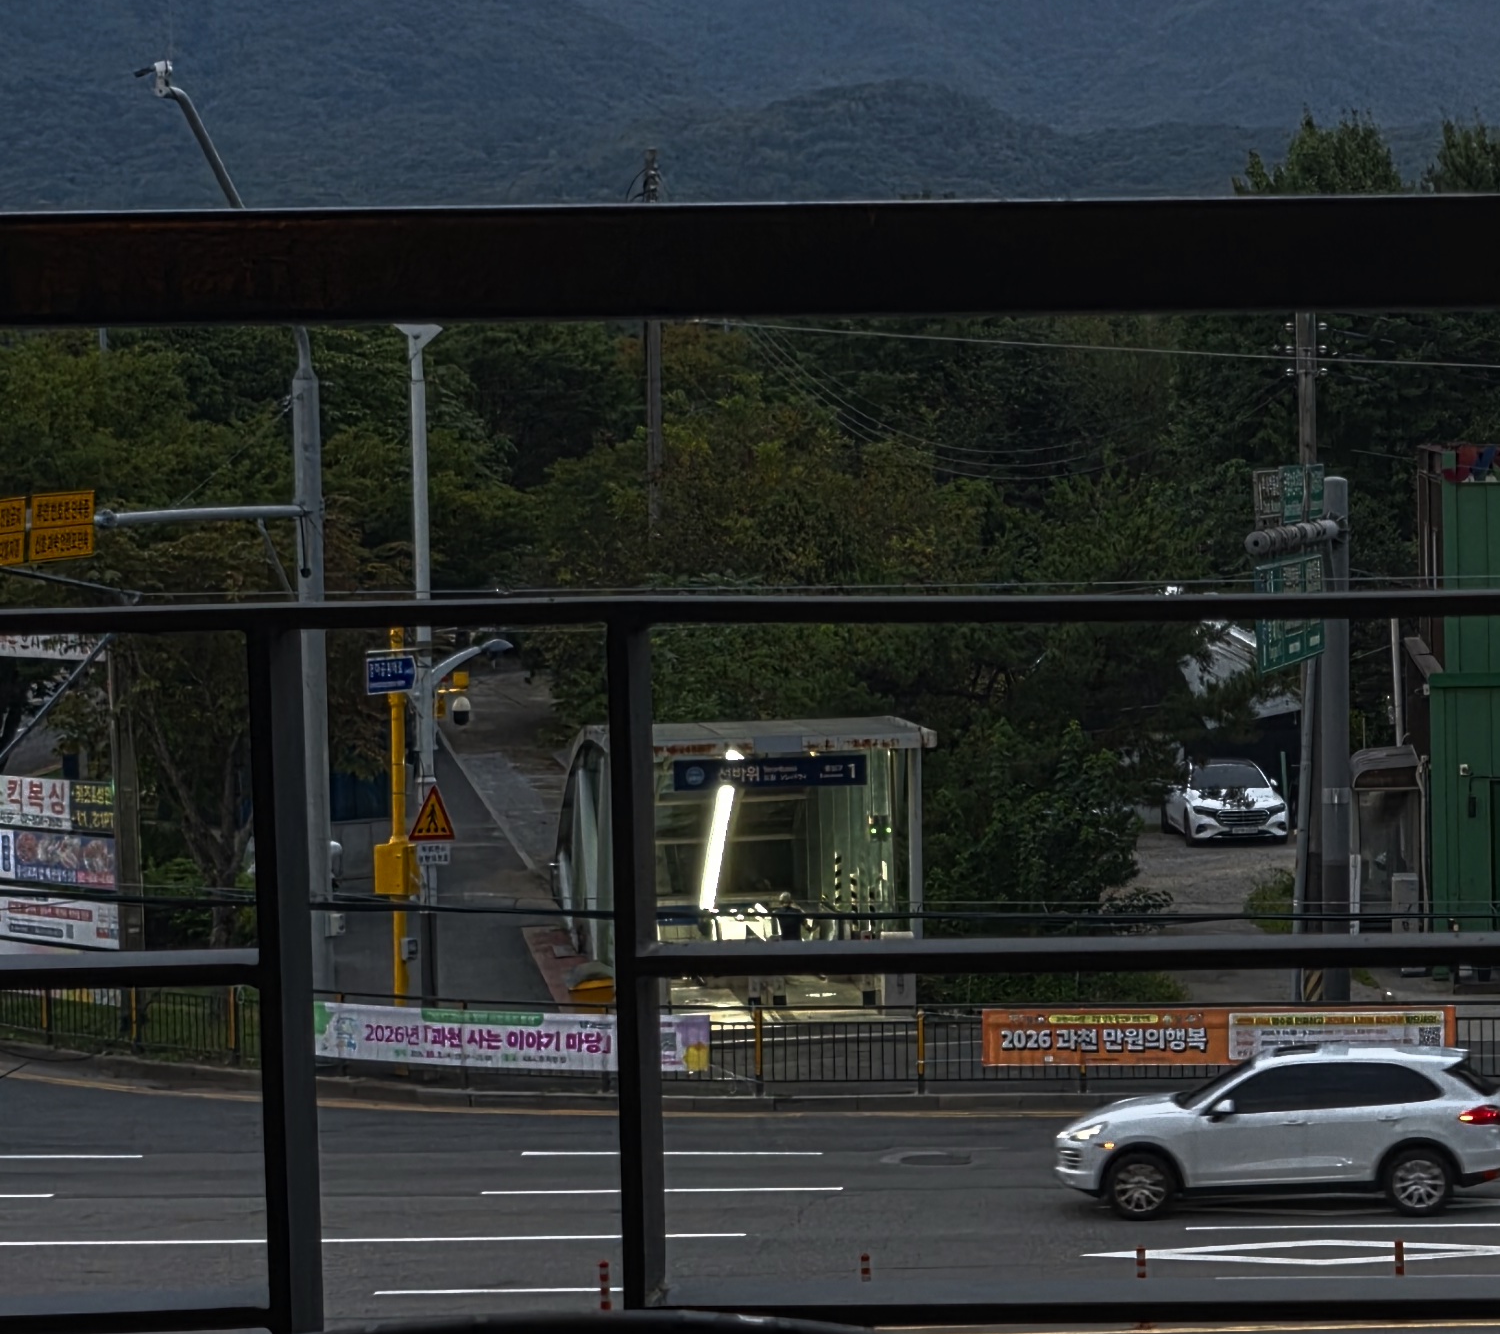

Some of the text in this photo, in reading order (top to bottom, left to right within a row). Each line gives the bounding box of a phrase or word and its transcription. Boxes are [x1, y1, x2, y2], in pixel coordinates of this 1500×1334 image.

[718, 765, 760, 782] 선바위
[847, 764, 856, 780] 1
[364, 1023, 421, 1046] 2026년
[467, 1028, 503, 1050] 사는
[506, 1029, 561, 1054] 이야기
[1000, 1026, 1208, 1052] 2026 과천 만원의행복
